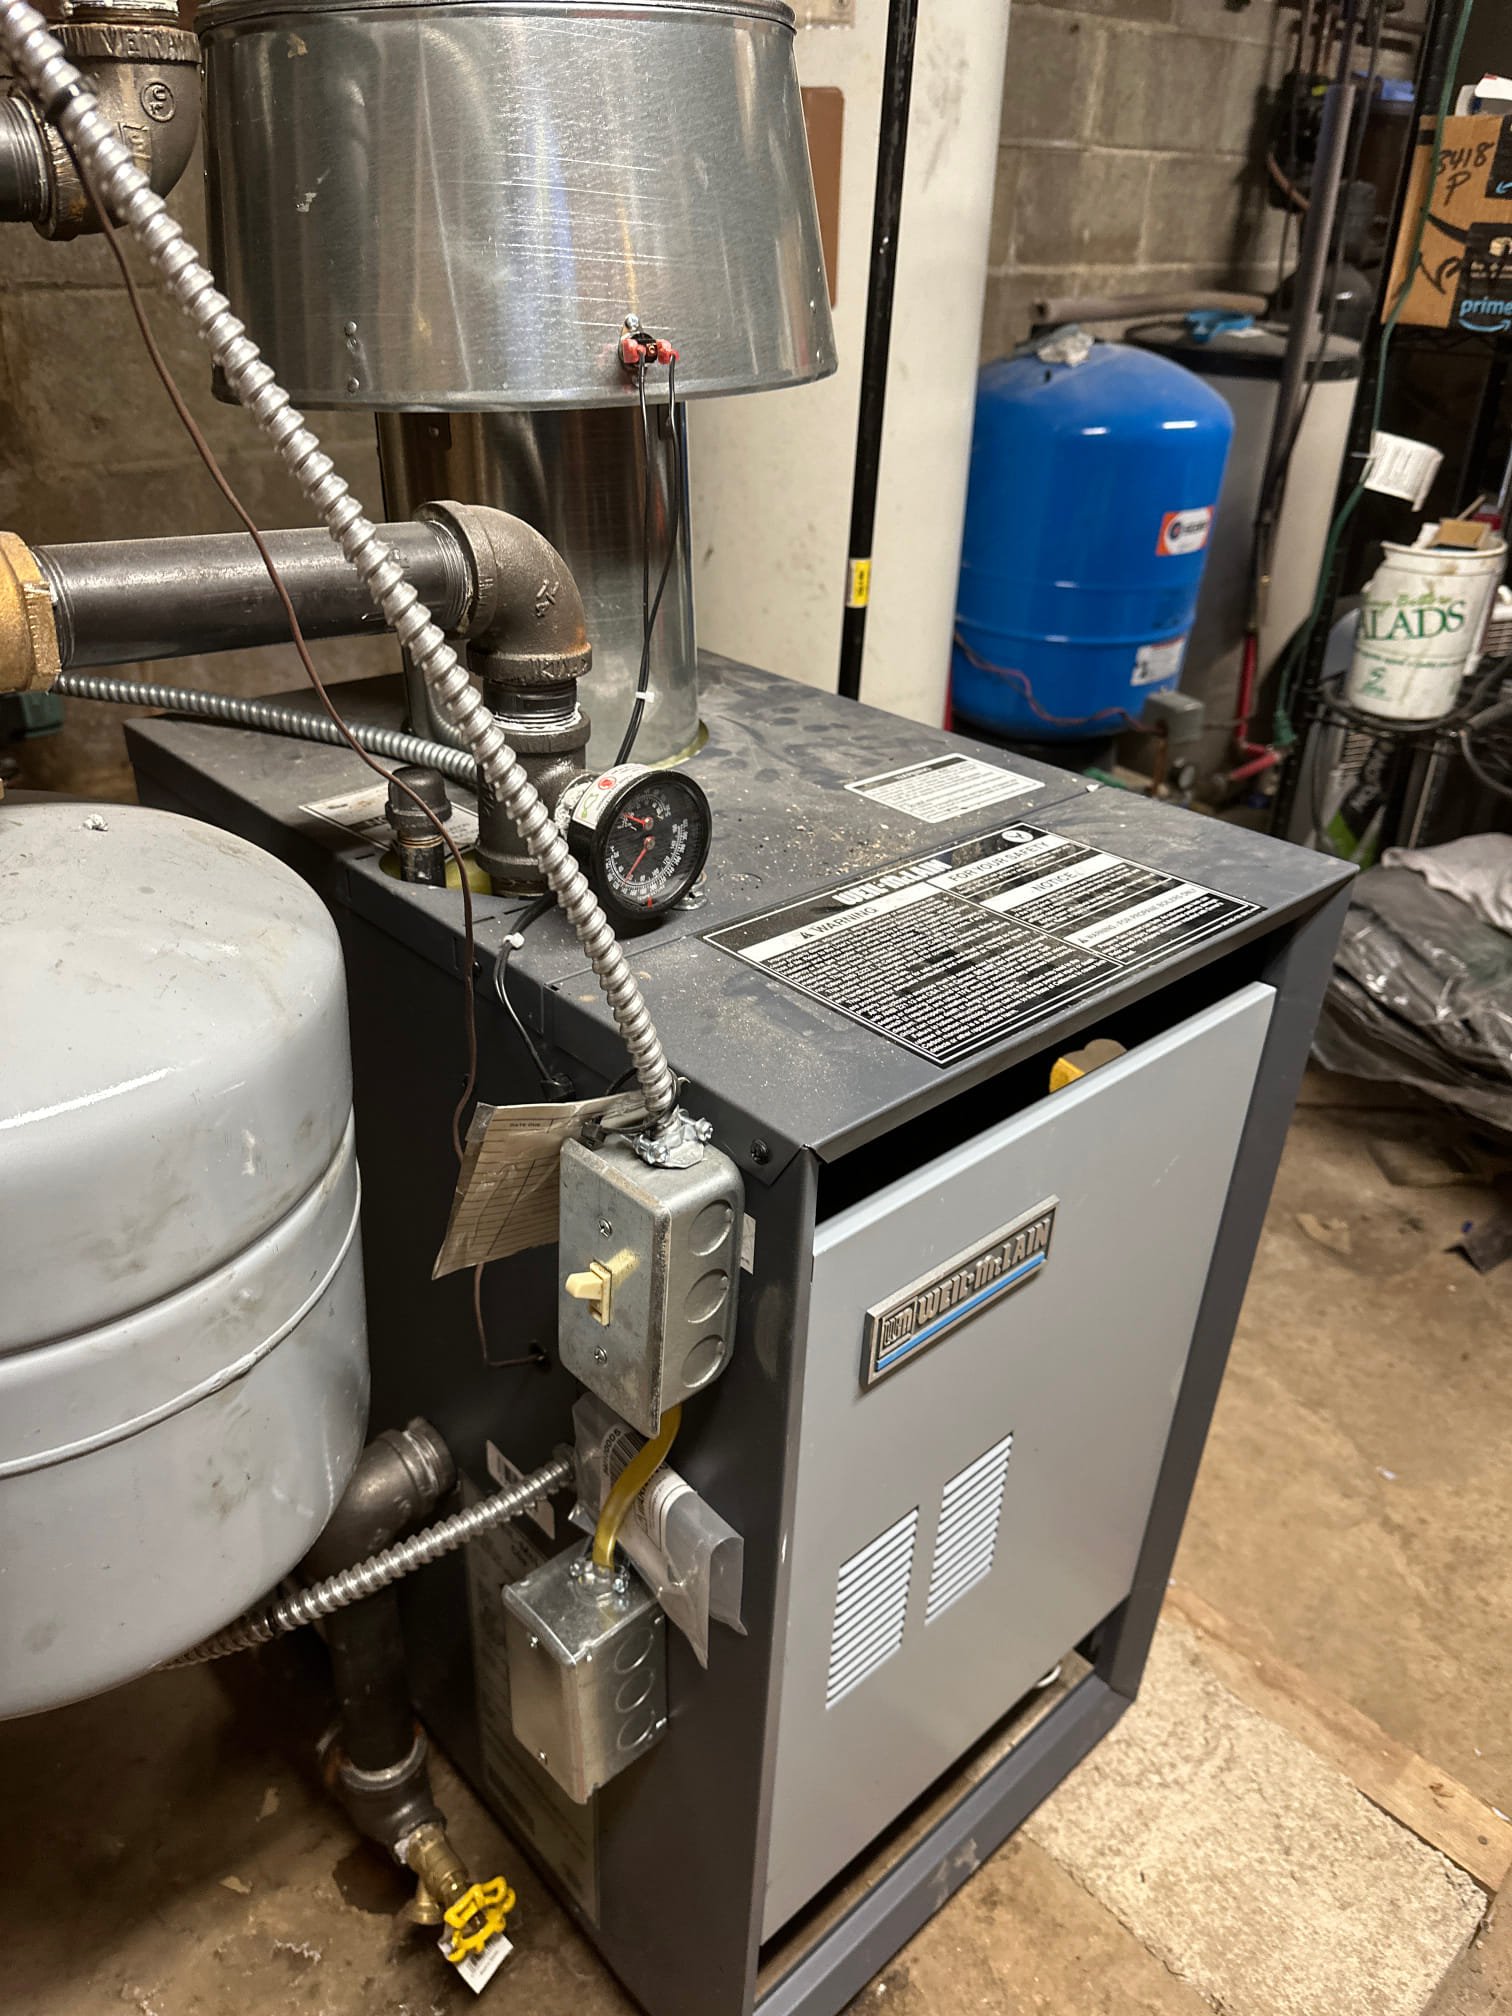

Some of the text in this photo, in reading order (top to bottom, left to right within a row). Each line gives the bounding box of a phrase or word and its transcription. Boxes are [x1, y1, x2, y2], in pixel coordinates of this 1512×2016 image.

[1460, 296, 1512, 317] prime
[948, 868, 976, 882] FOR
[974, 857, 1007, 873] YOUR
[1005, 841, 1051, 860] SAFETY
[1031, 871, 1075, 893] NOTICE
[811, 906, 878, 933] WARNING
